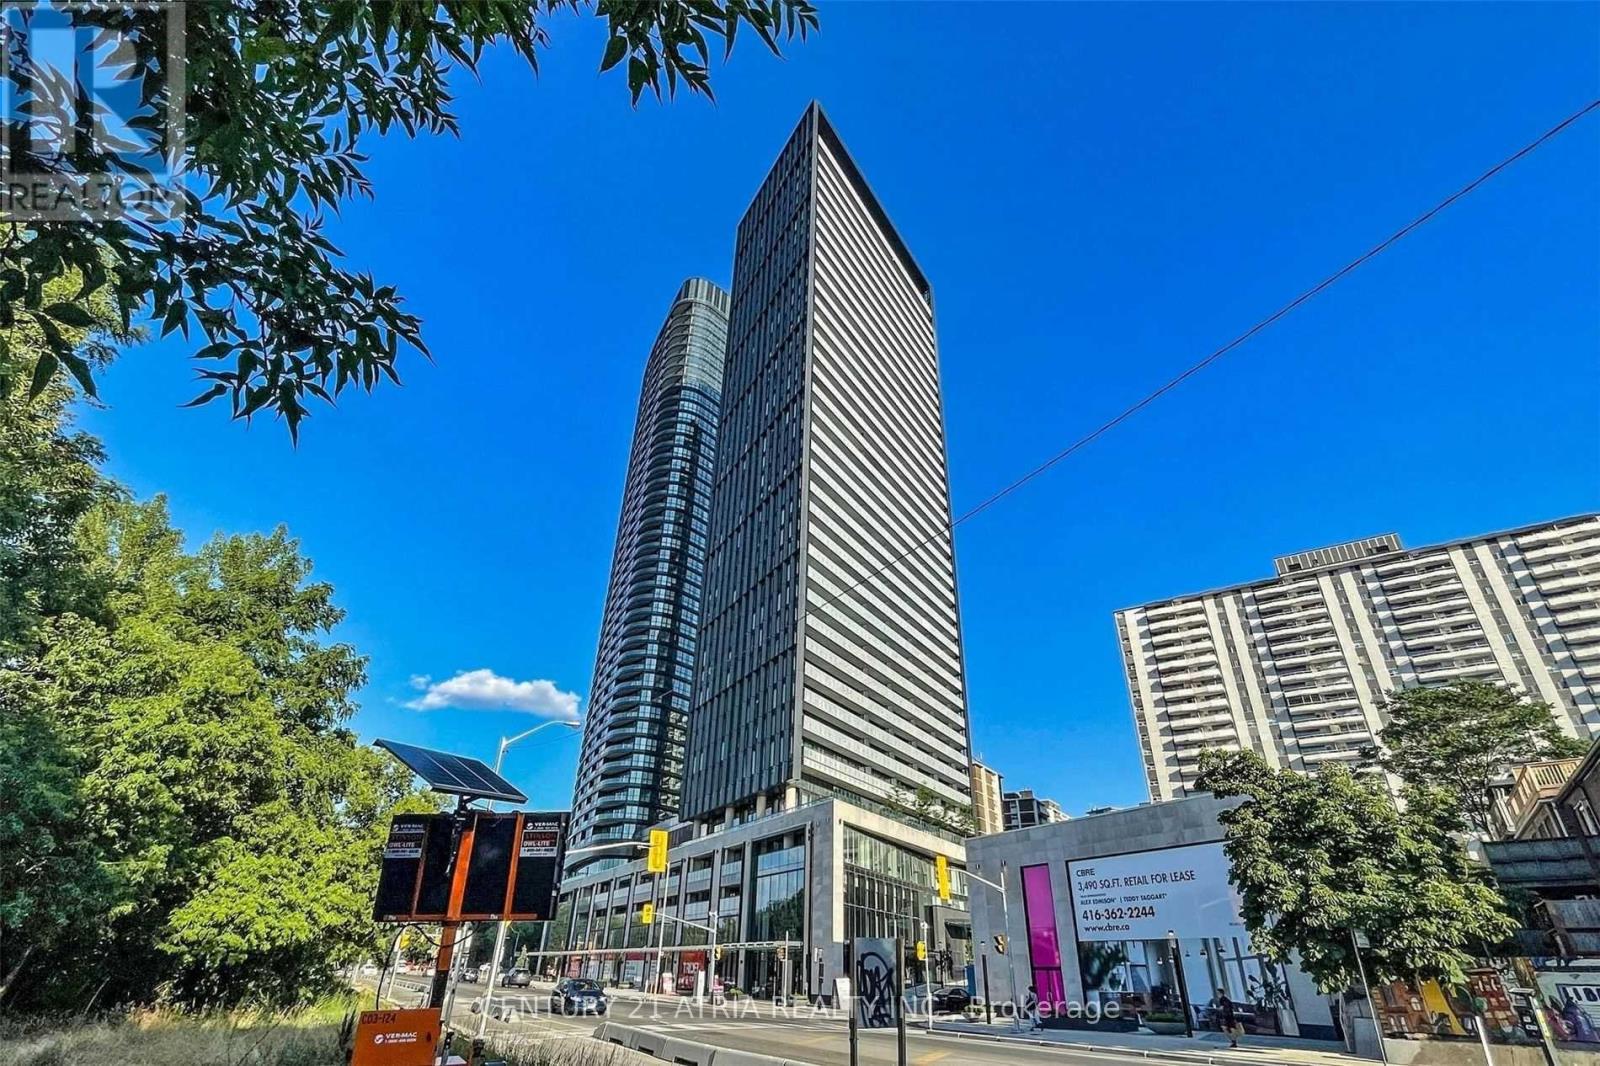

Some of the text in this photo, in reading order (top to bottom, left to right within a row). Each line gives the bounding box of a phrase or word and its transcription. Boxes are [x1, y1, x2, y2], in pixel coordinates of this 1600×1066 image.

[1076, 868, 1096, 877] CBRE
[1077, 870, 1196, 892] 3,490 SQ.FT. RETAIL FOR LEASE
[1082, 906, 1155, 921] 416-362-2244
[1084, 922, 1130, 932] www.cbre.ca
